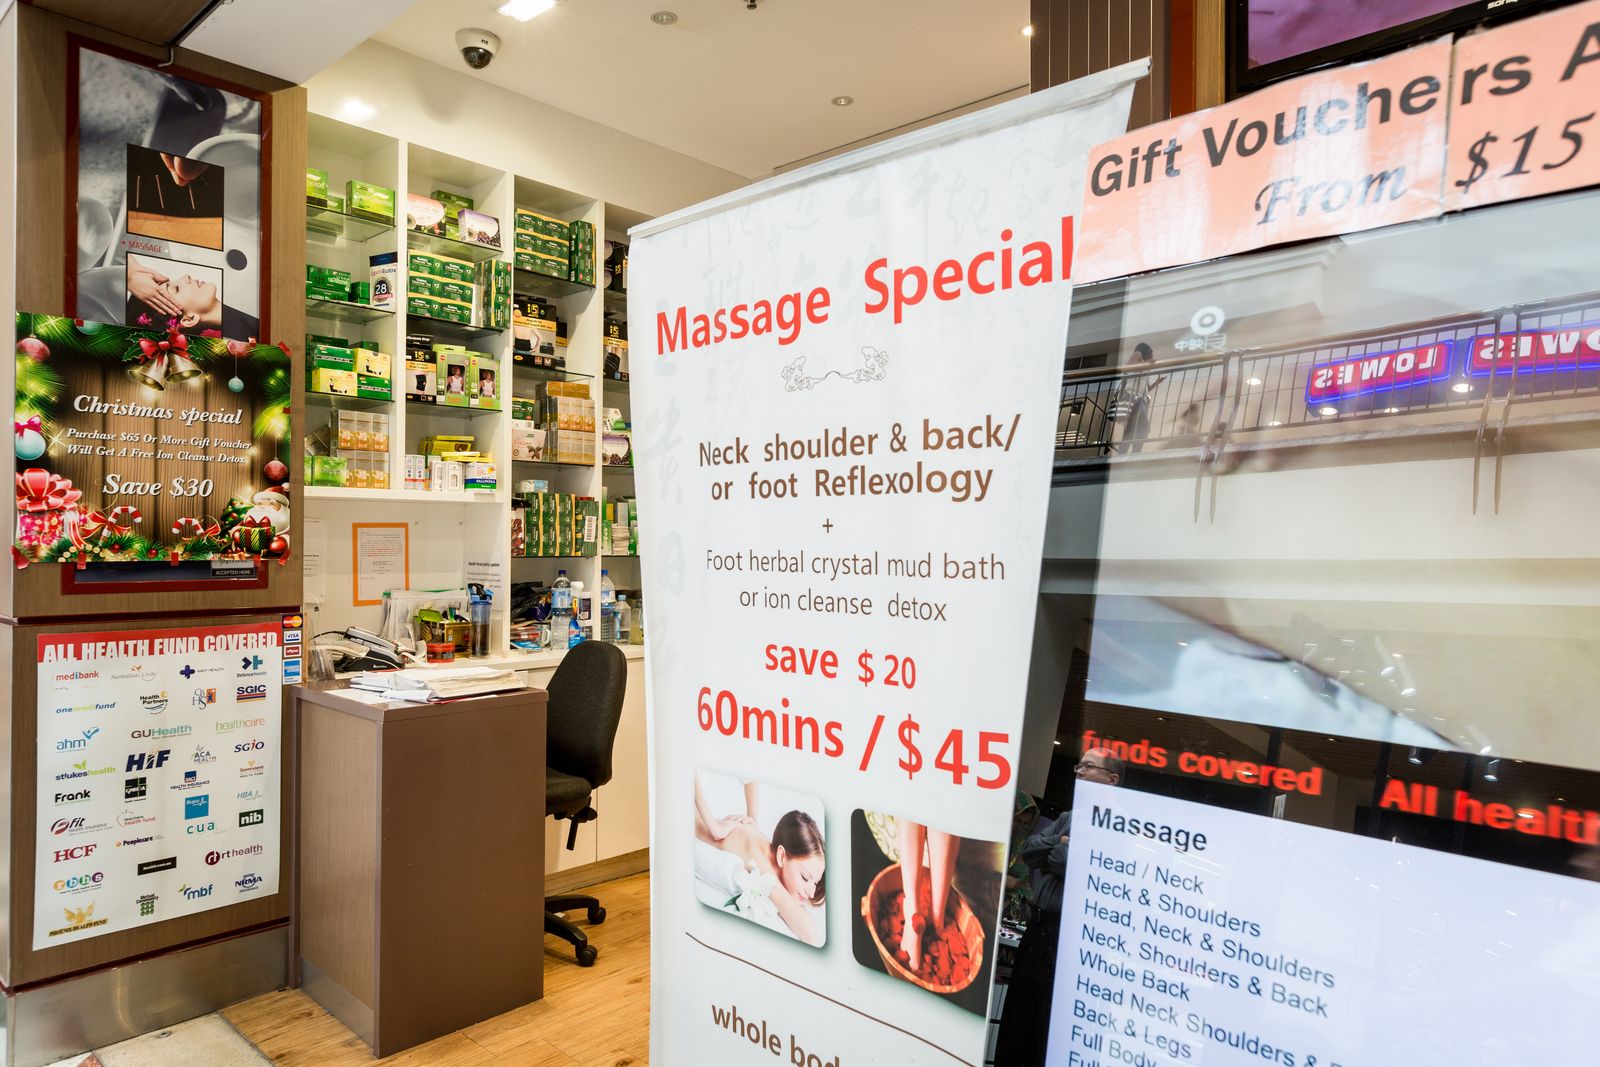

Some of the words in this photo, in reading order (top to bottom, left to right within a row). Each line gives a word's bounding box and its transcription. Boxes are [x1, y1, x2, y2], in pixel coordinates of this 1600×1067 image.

[1091, 138, 1182, 197] Gift
[1255, 162, 1407, 226] From
[1454, 112, 1596, 194] $15
[128, 240, 163, 253] MASSAGE
[376, 284, 387, 294] 28
[656, 284, 831, 355] Massage
[864, 216, 1074, 324] Special
[73, 394, 173, 419] Christmas
[180, 409, 243, 426] special
[66, 427, 117, 442] Purchase
[120, 432, 140, 443] $65
[143, 433, 157, 444] Or
[160, 435, 187, 446] More
[190, 436, 210, 448] Gift
[213, 438, 252, 450] Voucher
[66, 443, 92, 456] Will
[96, 446, 115, 457] Get
[117, 447, 127, 458] A
[131, 449, 153, 460] Free
[156, 450, 174, 461] Ion
[177, 451, 215, 463] Cleanse
[699, 437, 749, 467] Neck
[764, 427, 878, 464] shoulder
[890, 422, 907, 453] &
[922, 413, 1021, 452] back/
[103, 473, 162, 496] Save
[170, 476, 214, 499] $30
[712, 479, 733, 500] or
[749, 472, 798, 499] foot
[815, 461, 994, 503] Reflexology
[706, 549, 743, 571] Foot
[749, 549, 804, 574] herbal
[811, 551, 878, 581] crystal
[887, 553, 931, 579] mud
[943, 553, 1006, 580] bath
[739, 590, 758, 607] or
[764, 586, 791, 610] ion
[798, 588, 873, 615] cleanse
[887, 593, 947, 621] detox
[43, 643, 77, 663] ALL
[81, 639, 150, 660] HEALTH
[153, 636, 200, 656] FUND
[204, 631, 278, 652] COVERED
[765, 643, 839, 679] save
[56, 671, 100, 681] medibank
[236, 685, 266, 695] SGIC
[216, 717, 266, 732] healthcare
[697, 686, 844, 758] 60mins
[858, 714, 885, 772] /
[56, 738, 86, 751] ahm
[194, 751, 211, 759] ACA
[1178, 751, 1323, 796] covered
[54, 789, 91, 803] Frank
[1378, 778, 1438, 817] All
[69, 817, 86, 828] fit
[240, 812, 262, 825] nib
[1091, 805, 1207, 853] Massage
[53, 843, 97, 863] HCF
[231, 844, 263, 857] health
[1089, 849, 1136, 876] Head
[1142, 863, 1149, 879] /
[1155, 866, 1204, 894] Neck
[1087, 874, 1131, 901] Neck
[1138, 888, 1151, 906] &
[1158, 894, 1261, 937] Shoulders
[1084, 898, 1136, 932] Head,
[1144, 916, 1192, 946] Neck
[1200, 933, 1213, 952] &
[1222, 939, 1336, 988] Shoulders
[1080, 948, 1136, 983] Whole
[1142, 970, 1191, 1001] Back
[1082, 923, 1131, 957] Neck,
[1139, 943, 1240, 990] Shoulders
[1247, 976, 1262, 996] &
[1271, 982, 1329, 1018] Back
[711, 1004, 782, 1057] whole
[1073, 999, 1116, 1030] Back
[1124, 1019, 1137, 1038] &
[1144, 1025, 1192, 1060] Legs
[1076, 974, 1124, 1006] Head
[1131, 993, 1178, 1027] Neck
[1186, 1013, 1295, 1067] Shoulders
[1071, 1025, 1102, 1053] Full
[1108, 1040, 1158, 1067] Body
